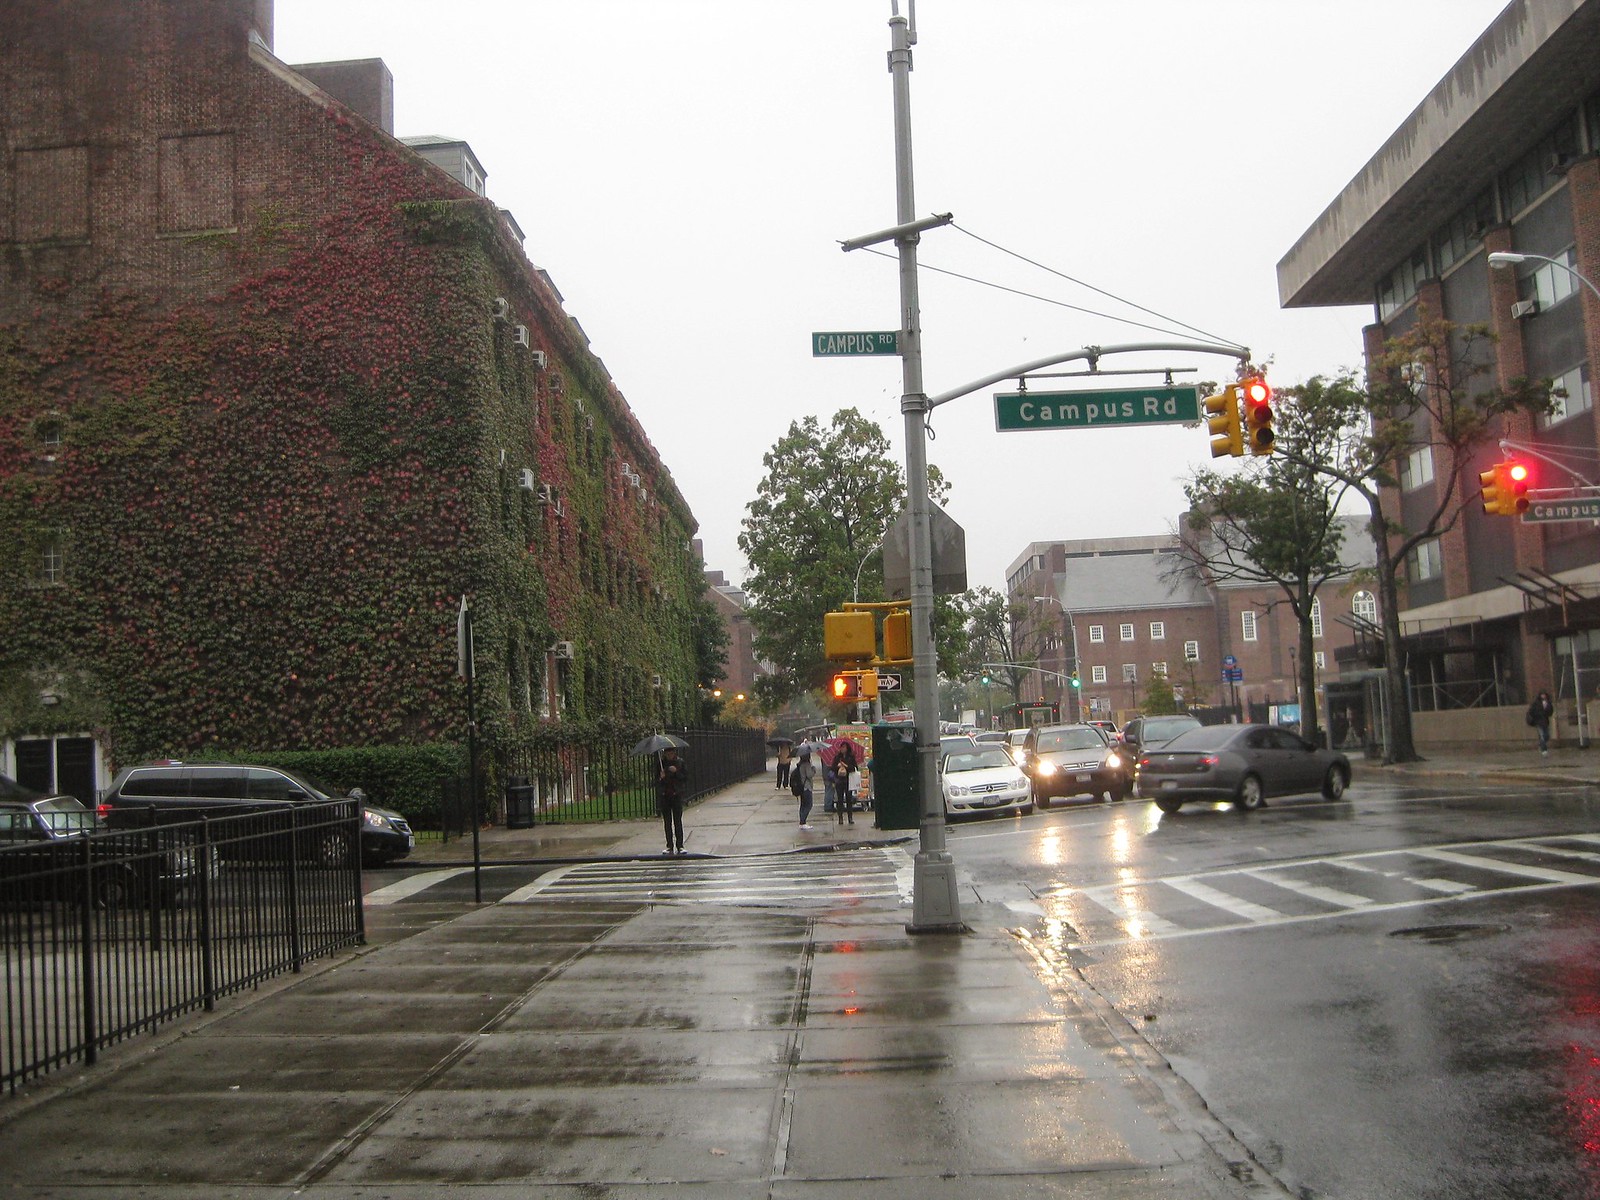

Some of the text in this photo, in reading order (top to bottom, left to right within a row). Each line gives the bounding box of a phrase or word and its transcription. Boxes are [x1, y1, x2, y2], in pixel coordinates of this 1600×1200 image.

[818, 334, 893, 353] CAMPUS RD
[1019, 397, 1177, 423] Campus Rd
[1534, 505, 1599, 518] Campus
